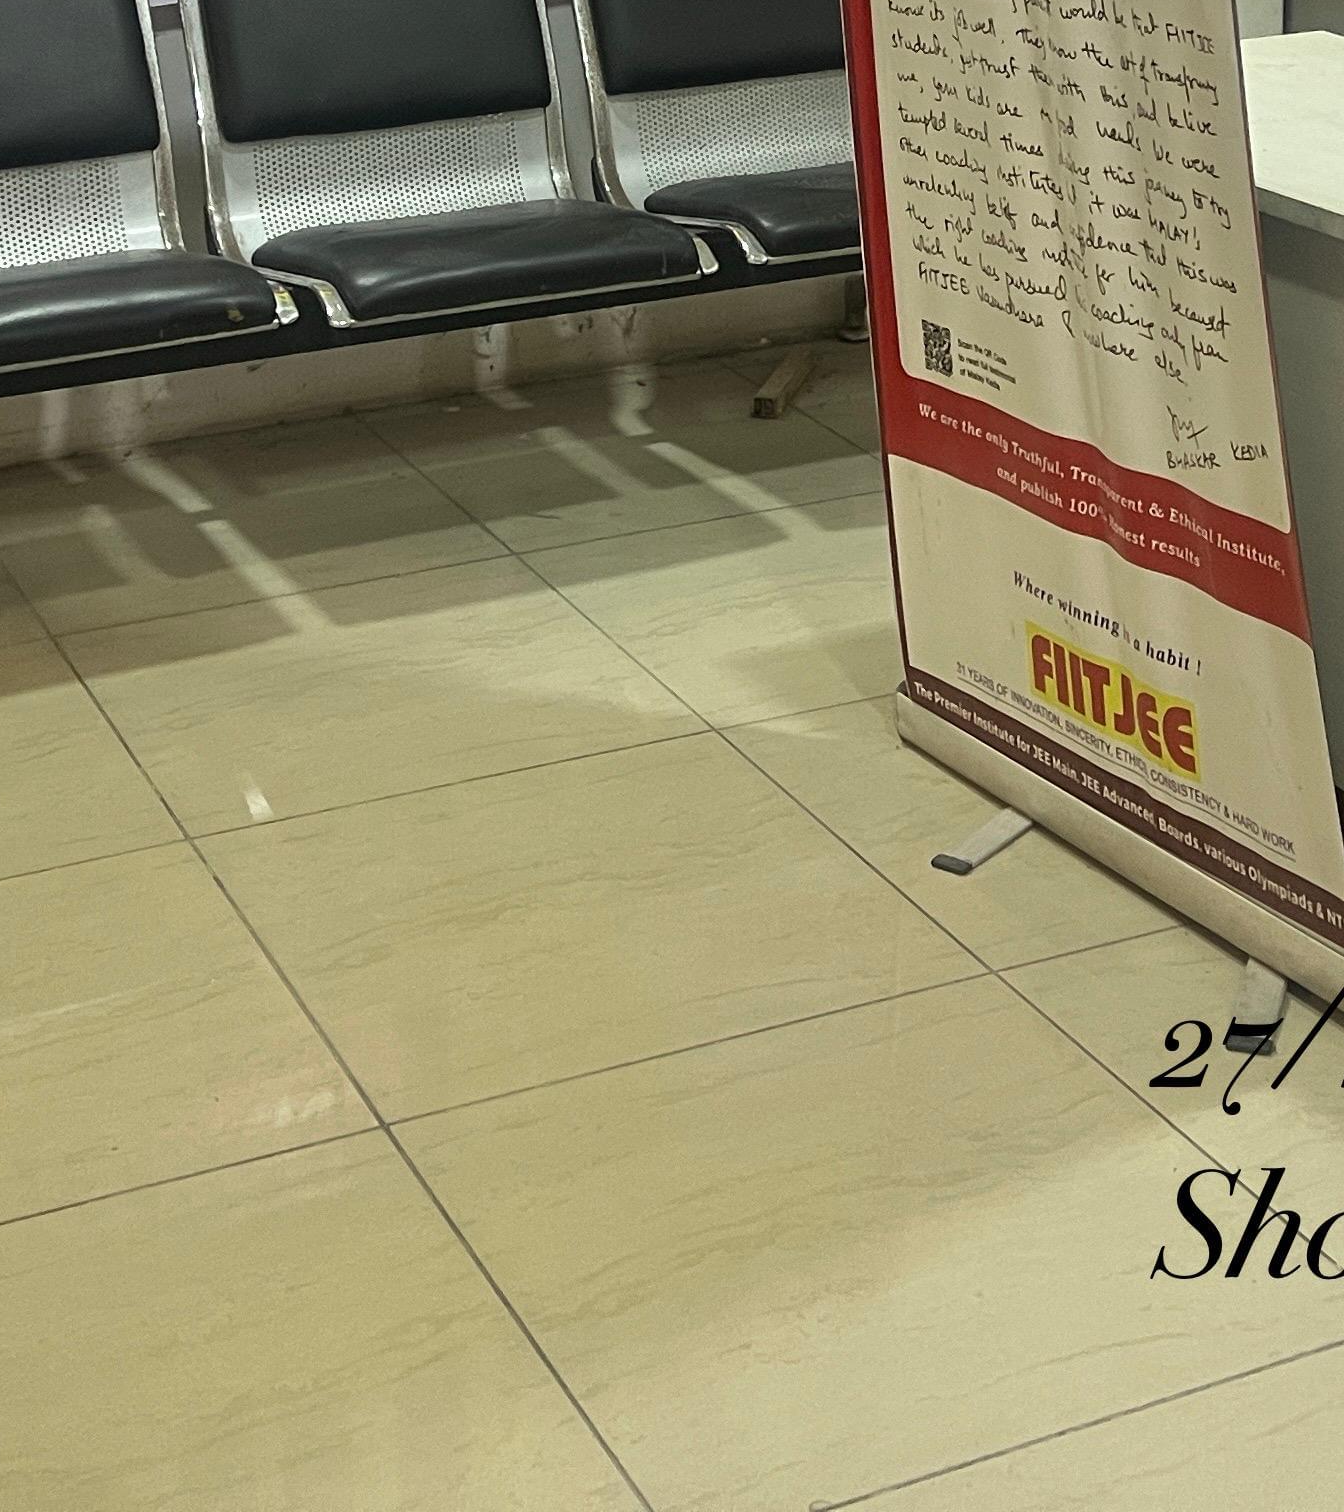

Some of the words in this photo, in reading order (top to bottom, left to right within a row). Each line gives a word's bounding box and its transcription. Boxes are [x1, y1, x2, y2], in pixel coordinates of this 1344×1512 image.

[919, 402, 937, 421] We
[940, 413, 958, 430] are
[961, 419, 982, 438] the
[985, 431, 1009, 454] only
[1011, 441, 1064, 478] Truthful,
[1148, 502, 1164, 517] &
[1169, 507, 1214, 544] Ethical
[1216, 533, 1285, 576] Institute,
[1230, 440, 1269, 460] KEDIA
[997, 467, 1017, 485] and
[1020, 479, 1063, 508] publish
[1151, 539, 1200, 567] results
[1014, 570, 1054, 606] Where
[1057, 599, 1119, 637] winning
[1146, 640, 1189, 670] habit
[1031, 633, 1197, 774] FIITJEE
[914, 681, 932, 701] The
[934, 690, 972, 721] Premier
[973, 711, 1015, 746] Institute
[1016, 734, 1031, 754] for
[1032, 743, 1051, 766] JEE
[1081, 771, 1100, 795] JEE
[1203, 843, 1246, 875] various
[1248, 866, 1313, 913] Olympiads
[1316, 902, 1325, 919] &
[1150, 768, 1221, 813] CONSISTENCY
[1233, 810, 1259, 835] HARD
[1261, 824, 1296, 855] WORK
